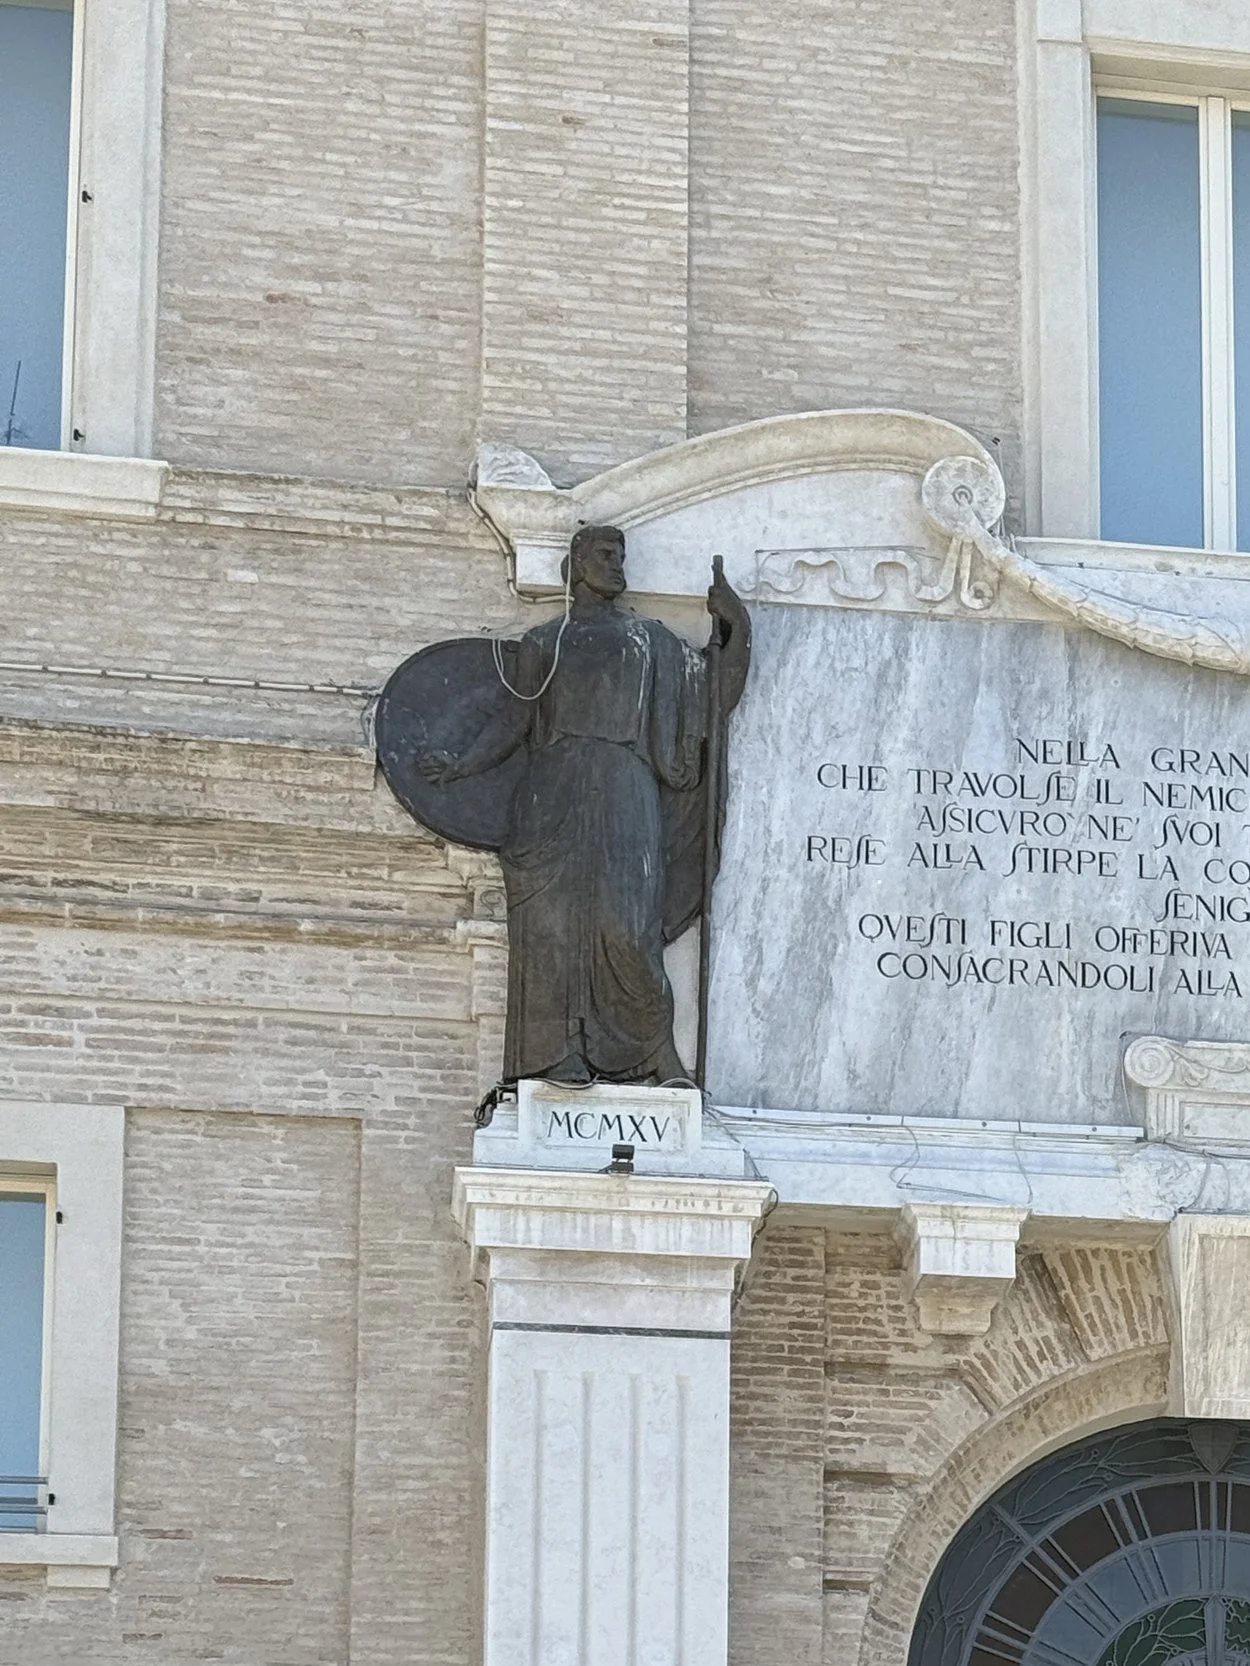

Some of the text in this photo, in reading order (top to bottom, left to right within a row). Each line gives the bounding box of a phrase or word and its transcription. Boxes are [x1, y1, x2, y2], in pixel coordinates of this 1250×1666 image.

[1016, 738, 1121, 769] NELLA
[817, 763, 887, 792] CHE
[907, 767, 1078, 807] TRAVOLSE
[1094, 779, 1124, 804] IL
[1154, 814, 1221, 850] SVOI
[807, 834, 887, 869] RESE
[907, 842, 986, 871] ALLA
[1003, 841, 1118, 878] STIRPE
[1137, 853, 1179, 881] LA
[859, 912, 966, 948] QVESTI
[989, 920, 1072, 950] FIGLI
[1095, 925, 1232, 960] OFFERIVA
[876, 952, 1154, 992] CONSACRANDOLI
[1173, 969, 1242, 998] ALLA
[547, 1110, 671, 1142] MCMXV
